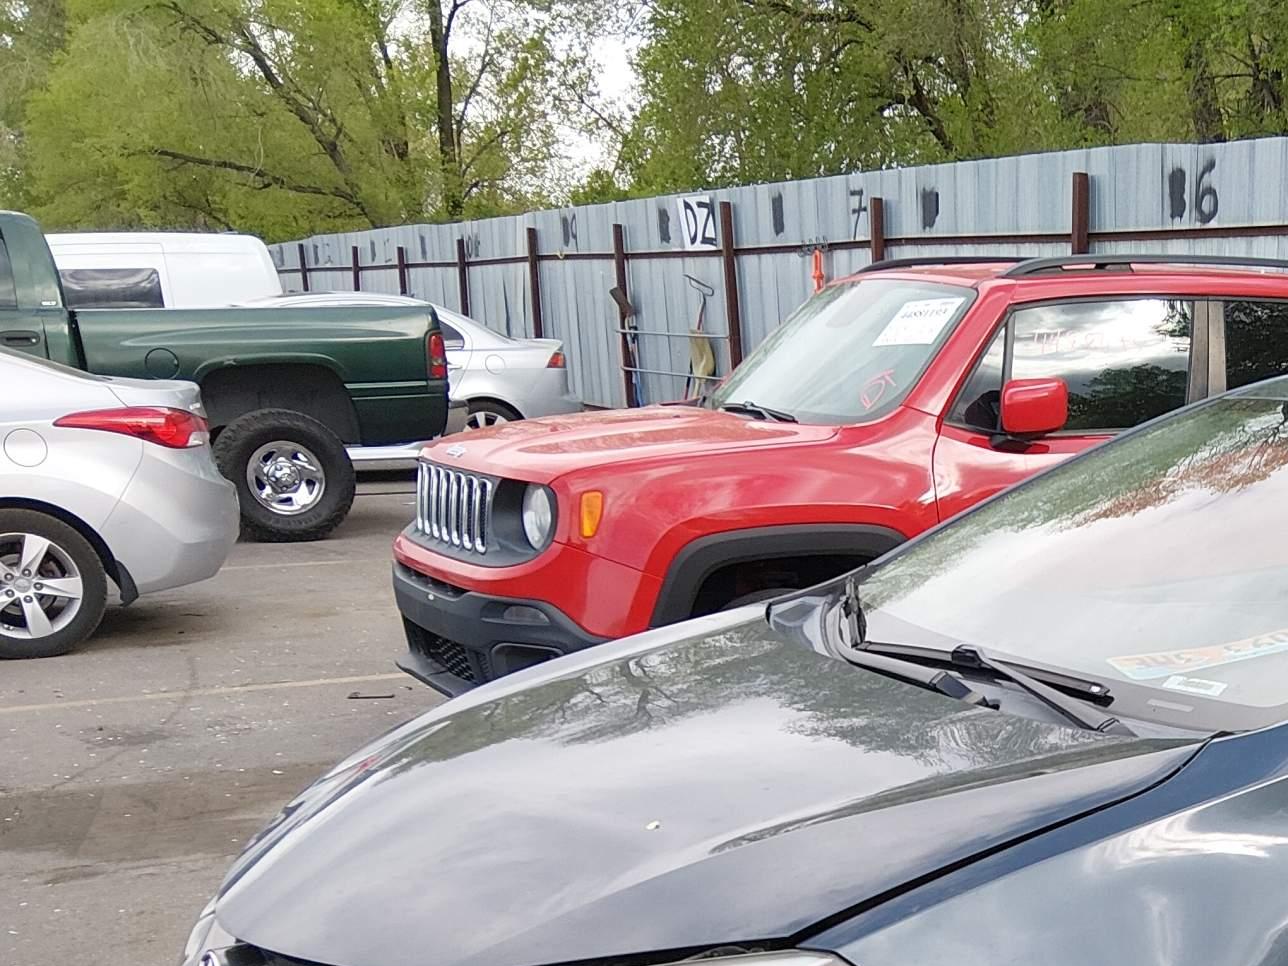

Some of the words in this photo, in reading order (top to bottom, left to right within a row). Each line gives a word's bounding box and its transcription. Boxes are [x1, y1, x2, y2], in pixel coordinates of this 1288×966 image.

[849, 188, 868, 241] 7
[1197, 158, 1219, 225] 6
[682, 198, 718, 247] DZ
